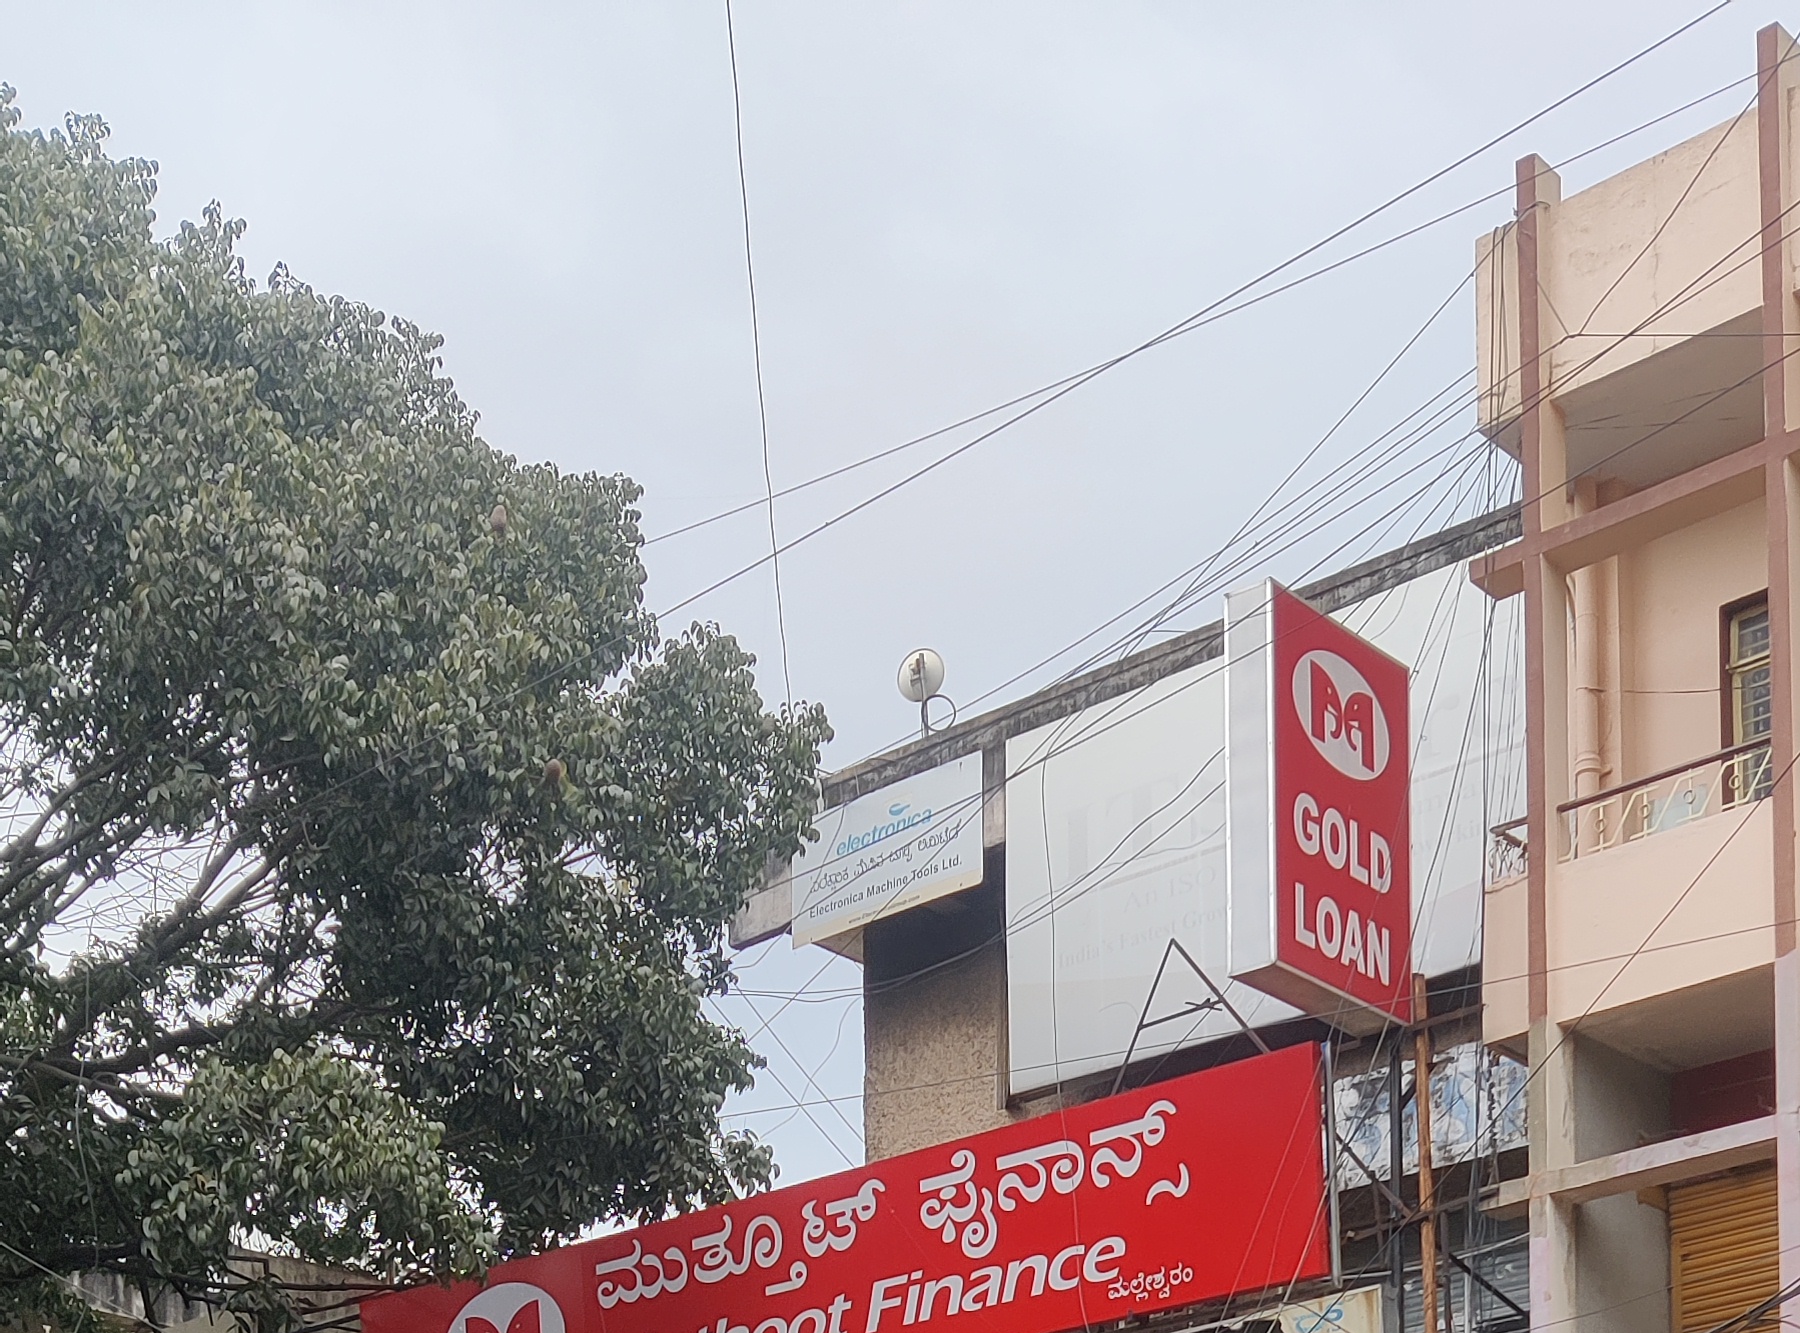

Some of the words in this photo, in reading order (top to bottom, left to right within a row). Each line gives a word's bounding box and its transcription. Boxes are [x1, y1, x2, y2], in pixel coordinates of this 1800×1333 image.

[837, 806, 933, 856] electronica
[1294, 792, 1392, 895] GOLD
[809, 887, 864, 919] Electronica
[866, 873, 908, 899] Machine
[911, 862, 939, 882] Tools
[942, 853, 963, 871] Ltd.
[1294, 882, 1390, 987] LOAN
[596, 1179, 886, 1309] ಮುತ್ತೂಟ್
[919, 1099, 1190, 1259] ಫೈನಾನ್ಸ್
[864, 1235, 1126, 1333] Finance
[1108, 1265, 1194, 1303] ಮಲ್ಲೇಶ್ವರಂ
